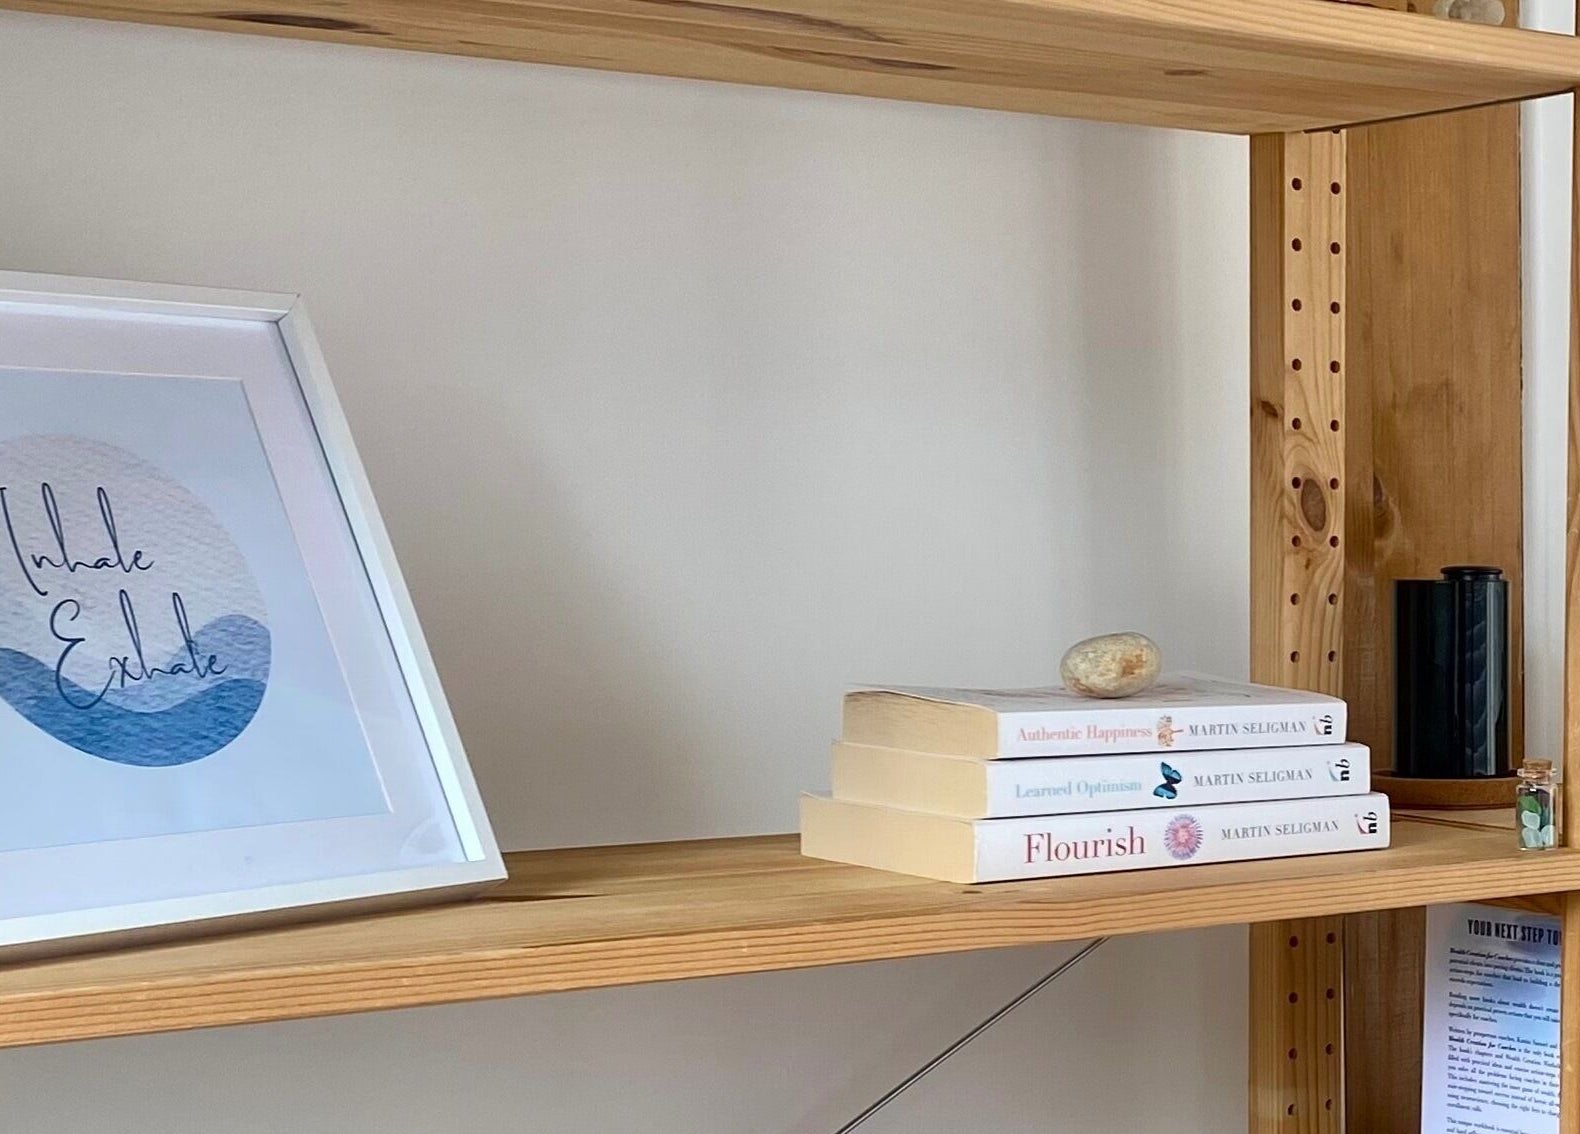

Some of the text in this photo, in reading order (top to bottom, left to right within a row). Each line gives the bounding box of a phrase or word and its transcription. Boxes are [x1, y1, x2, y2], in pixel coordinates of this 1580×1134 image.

[0, 482, 154, 597] Inhale
[49, 589, 230, 710] Exhale
[1018, 727, 1081, 743] Authentic
[1086, 725, 1152, 744] Happiness
[1188, 722, 1239, 737] MARTIN
[1242, 720, 1307, 735] SELIGMAN
[1016, 784, 1072, 800] Learned
[1076, 779, 1142, 798] Optimism
[1192, 773, 1245, 788] MARTIN
[1248, 768, 1314, 785] SELIGMAN
[1022, 825, 1147, 864] Flourish
[1220, 825, 1271, 841] MARTIN
[1274, 820, 1340, 836] SELIGMAN
[1467, 919, 1492, 937] YOUR
[1494, 922, 1519, 940] NEXT
[1520, 925, 1545, 943] STEP
